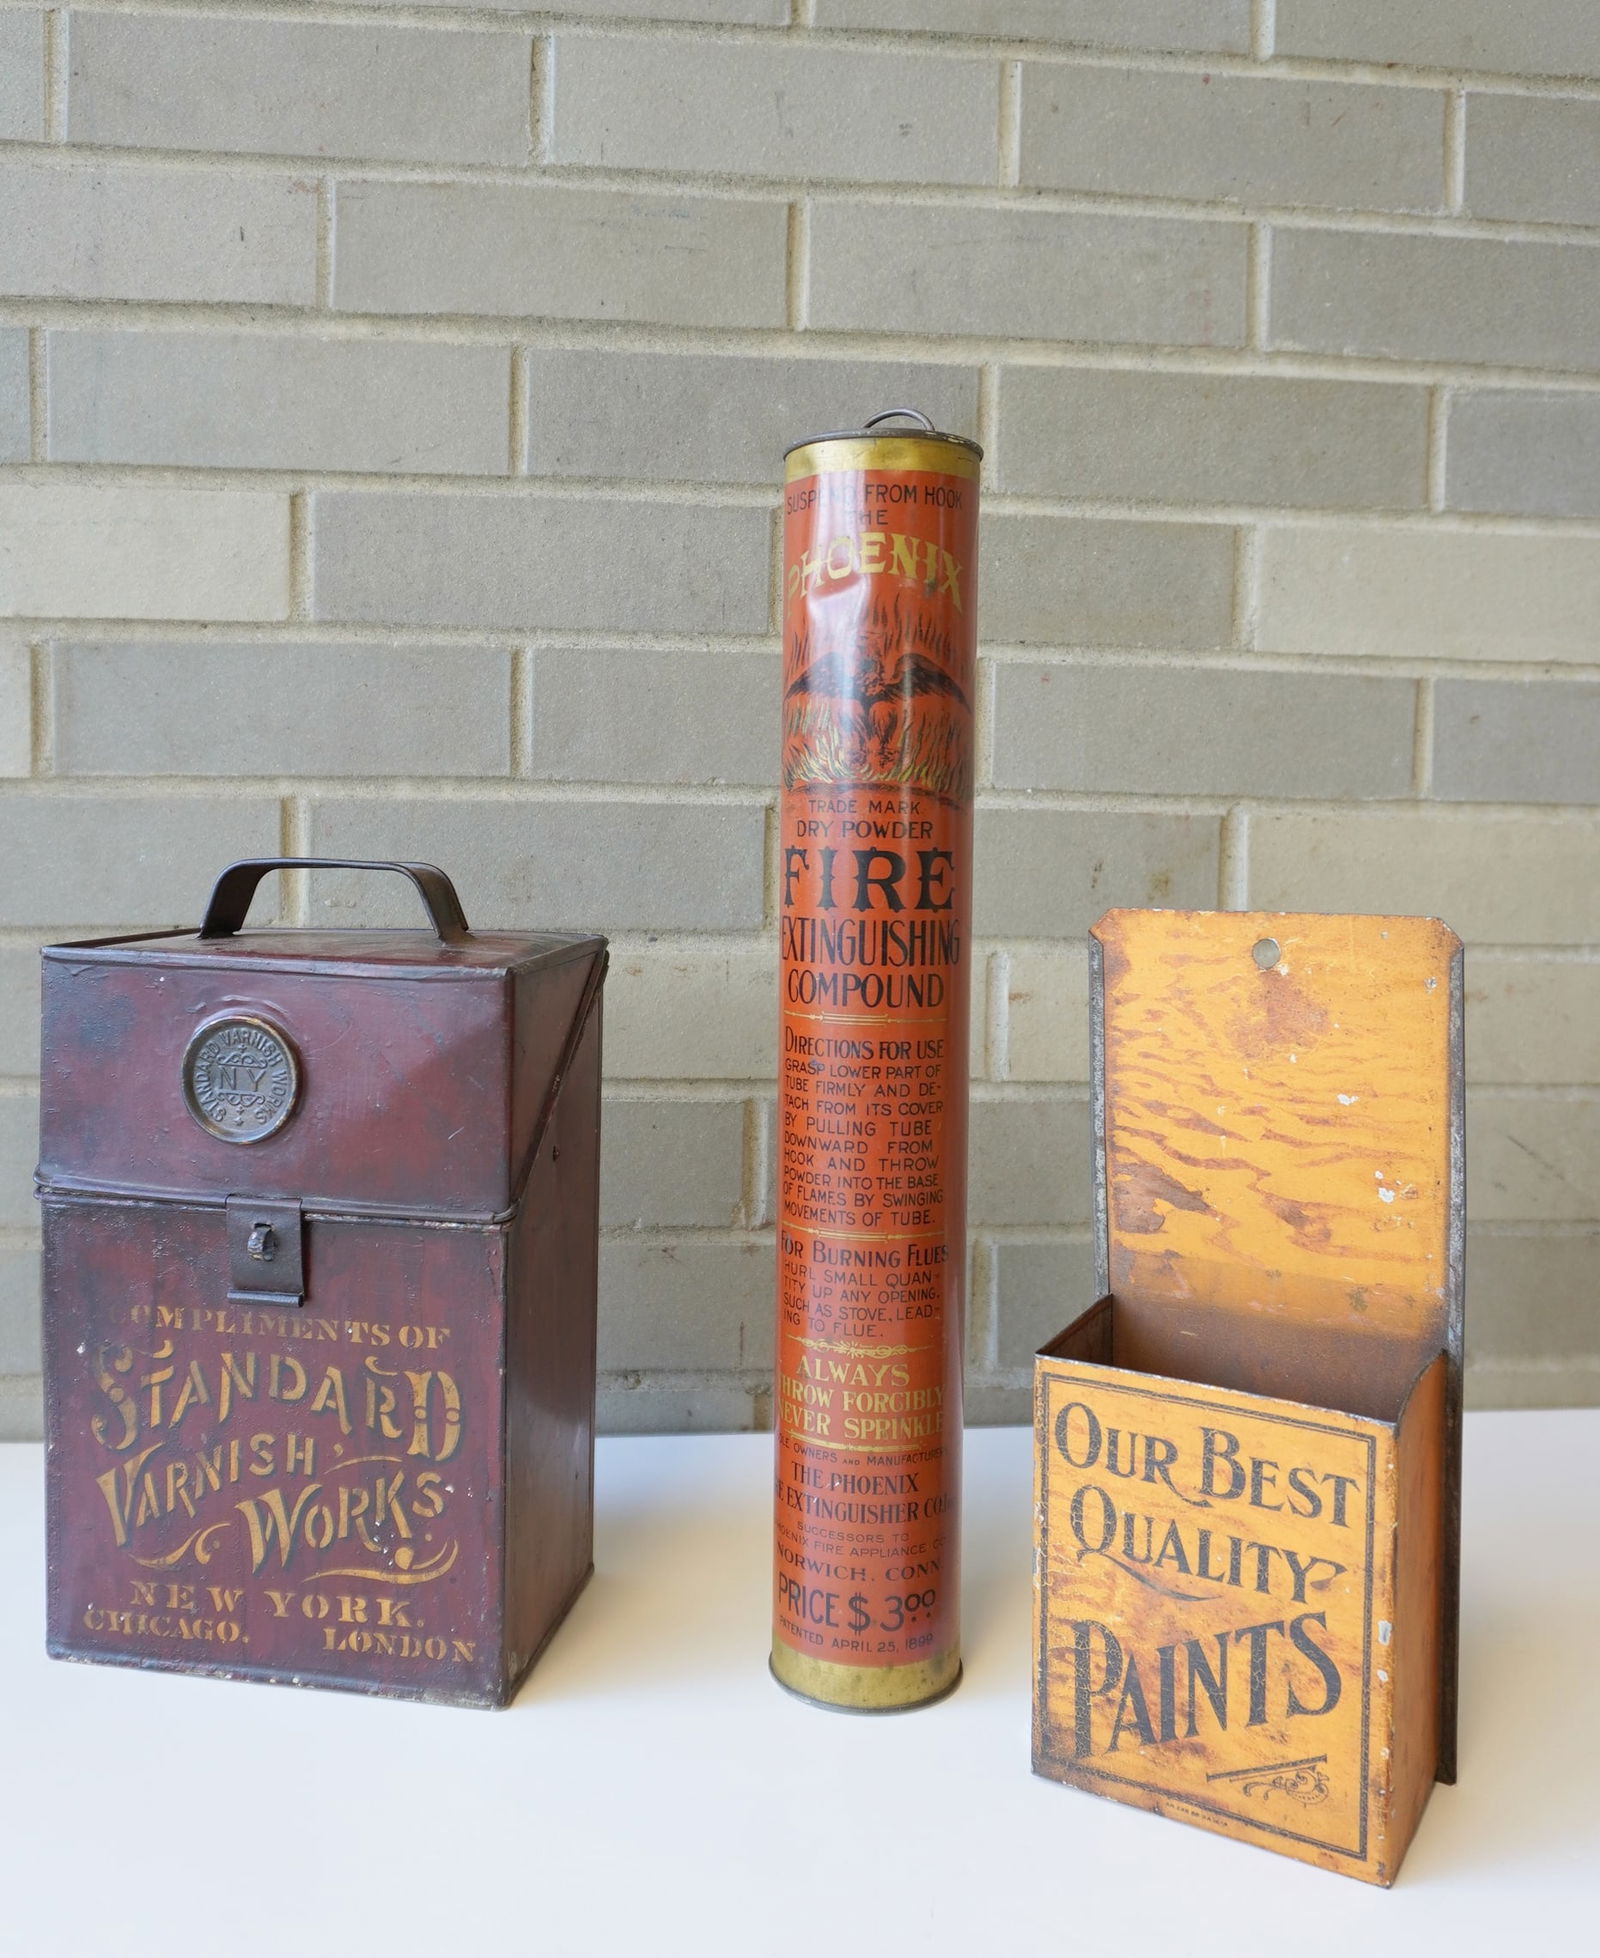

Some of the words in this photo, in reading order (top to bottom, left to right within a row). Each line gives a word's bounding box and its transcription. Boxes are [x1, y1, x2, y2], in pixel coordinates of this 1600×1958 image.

[787, 485, 857, 515] SUSPND
[865, 484, 917, 504] FROM
[924, 487, 963, 510] HOOK
[787, 531, 964, 617] PHOENIX
[808, 799, 857, 815] TRADE
[869, 800, 920, 815] MARK
[797, 820, 834, 838] DRY
[842, 820, 933, 840] POWDER
[784, 845, 956, 913] FIRE
[781, 915, 960, 967] EXTINGUISHING
[788, 968, 944, 1009] COMPOUND
[784, 1026, 874, 1059] DIRECTIONS
[879, 1041, 912, 1060] FOR
[916, 1039, 945, 1060] USE
[784, 1057, 825, 1076] GRASP
[830, 1064, 881, 1080] LOWER
[886, 1065, 921, 1080] PART
[925, 1064, 943, 1078] OF
[785, 1075, 809, 1093] TUBE
[816, 1081, 865, 1098] FIRMLY
[874, 1083, 911, 1098] AND
[919, 1082, 942, 1097] DE-
[785, 1094, 809, 1111] TACH
[816, 1100, 856, 1116] FROM
[866, 1103, 892, 1116] ITS
[897, 1101, 943, 1116] COVER
[784, 1111, 797, 1127] BY
[806, 1117, 876, 1137] PULLING
[889, 1120, 933, 1137] TUBE
[784, 1130, 869, 1155] DOWNWARD
[887, 1140, 933, 1155] FROM
[784, 1149, 814, 1168] HOOK
[827, 1157, 866, 1172] AND
[878, 1157, 939, 1172] THROW
[784, 1166, 831, 1188] POWDER
[837, 1176, 873, 1191] INTO
[876, 1176, 903, 1190] THE
[907, 1174, 939, 1190] BASE
[783, 1180, 793, 1195] OF
[797, 1185, 847, 1207] FLAMES
[854, 1194, 875, 1208] BY
[882, 1189, 944, 1209] SWINGING
[784, 1200, 856, 1226] MOVEMENTS
[862, 1212, 884, 1227] OF
[892, 1210, 937, 1226] TUBE.
[781, 1230, 804, 1260] FOR
[813, 1239, 901, 1268] BURNING
[907, 1243, 948, 1267] FLUES
[784, 1261, 816, 1281] HURL
[823, 1269, 877, 1287] SMALL
[885, 1272, 940, 1289] QUAN-
[784, 1276, 806, 1294] TITY
[812, 1286, 833, 1299] UP
[840, 1291, 871, 1304] ANY
[784, 1293, 810, 1313] SUCH
[815, 1304, 833, 1318] AS
[839, 1307, 893, 1322] STOVE,
[896, 1305, 941, 1321] LEAD-
[398, 1325, 451, 1350] OF
[784, 1311, 801, 1326] ING
[808, 1318, 826, 1333] TO
[833, 1322, 884, 1338] FLUE.
[797, 1356, 911, 1387] ALWAYS
[90, 1340, 462, 1462] STANDARD
[780, 1375, 834, 1409] HROW
[842, 1384, 945, 1414] FORCIBLY
[844, 1412, 944, 1441] SPRINKLE
[793, 1442, 838, 1464] OWNERS
[842, 1458, 860, 1467] AND
[1054, 1402, 1212, 1509] OUR
[1200, 1426, 1361, 1528] BEST
[96, 1433, 317, 1548] VARNISH
[792, 1461, 823, 1489] THE
[829, 1472, 919, 1496] PHOENIX
[787, 1486, 919, 1525] EXTINGUISHER
[797, 1521, 884, 1544] SUCCESSORS
[893, 1534, 909, 1544] TO
[1070, 1485, 1346, 1605] QUALITY
[777, 1540, 876, 1581] NORWICH.
[814, 1541, 844, 1556] FIRE
[850, 1543, 927, 1559] APPLIANCE
[130, 1580, 244, 1615] NEW
[264, 1590, 425, 1629] YORK.
[778, 1570, 841, 1628] PRICE
[84, 1609, 250, 1645] CHICAGO.
[778, 1614, 824, 1646] PATENTED
[831, 1637, 873, 1653] APRIL
[1072, 1611, 1343, 1762] PAINTS
